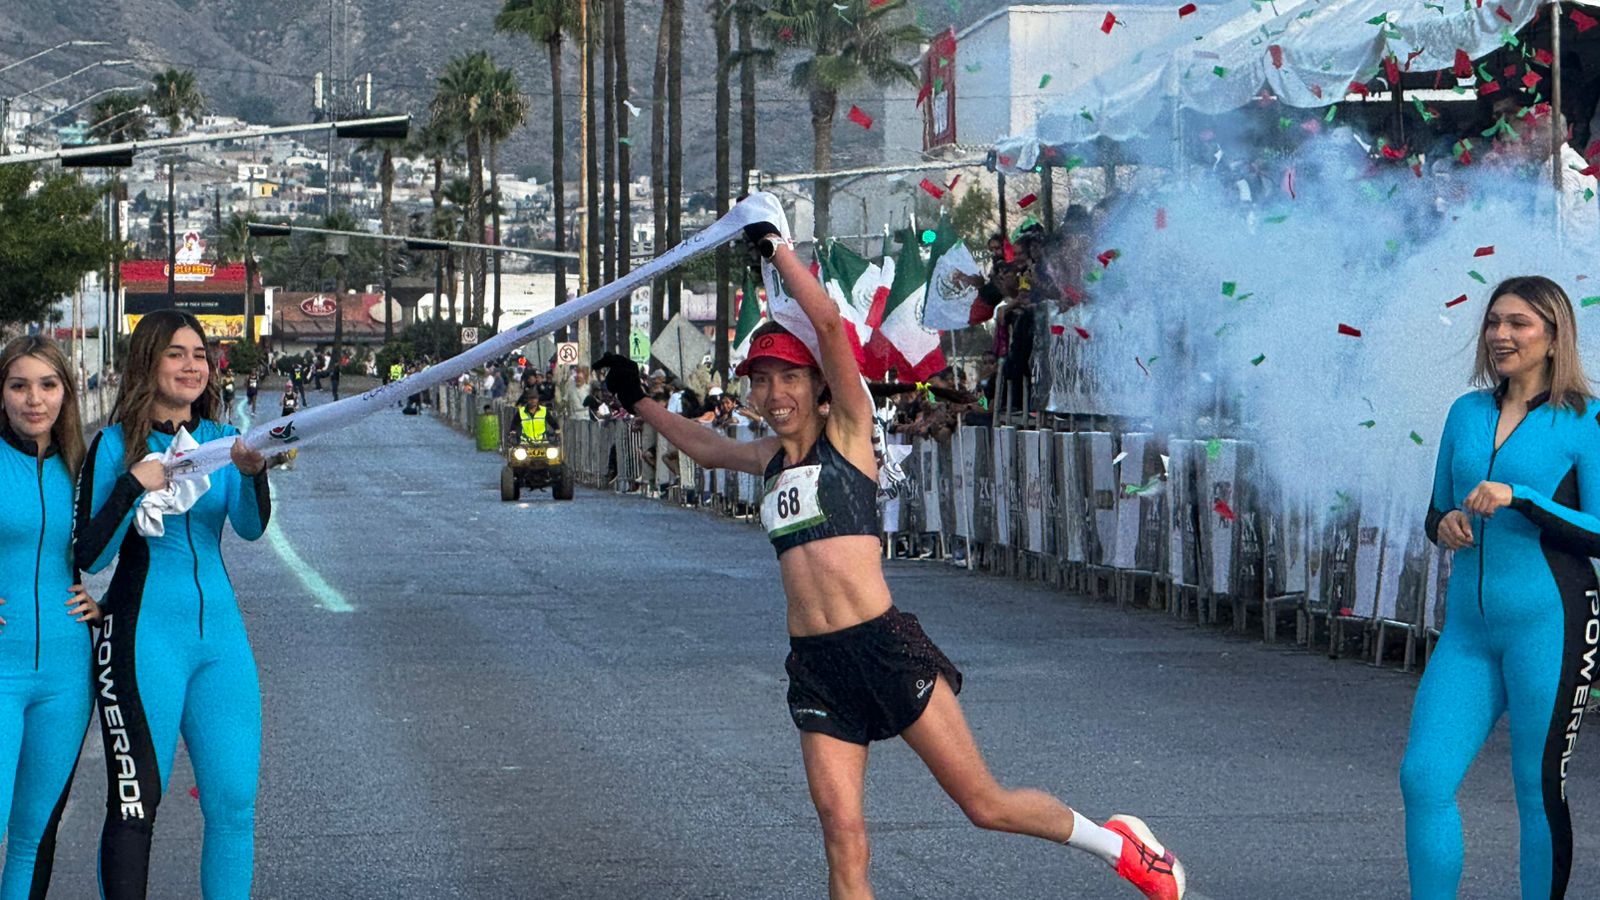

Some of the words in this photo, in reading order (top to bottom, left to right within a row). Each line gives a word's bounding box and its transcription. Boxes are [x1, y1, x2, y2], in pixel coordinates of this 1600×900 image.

[165, 264, 192, 273] PLLO
[777, 486, 801, 519] 68
[98, 613, 145, 821] POWERADE
